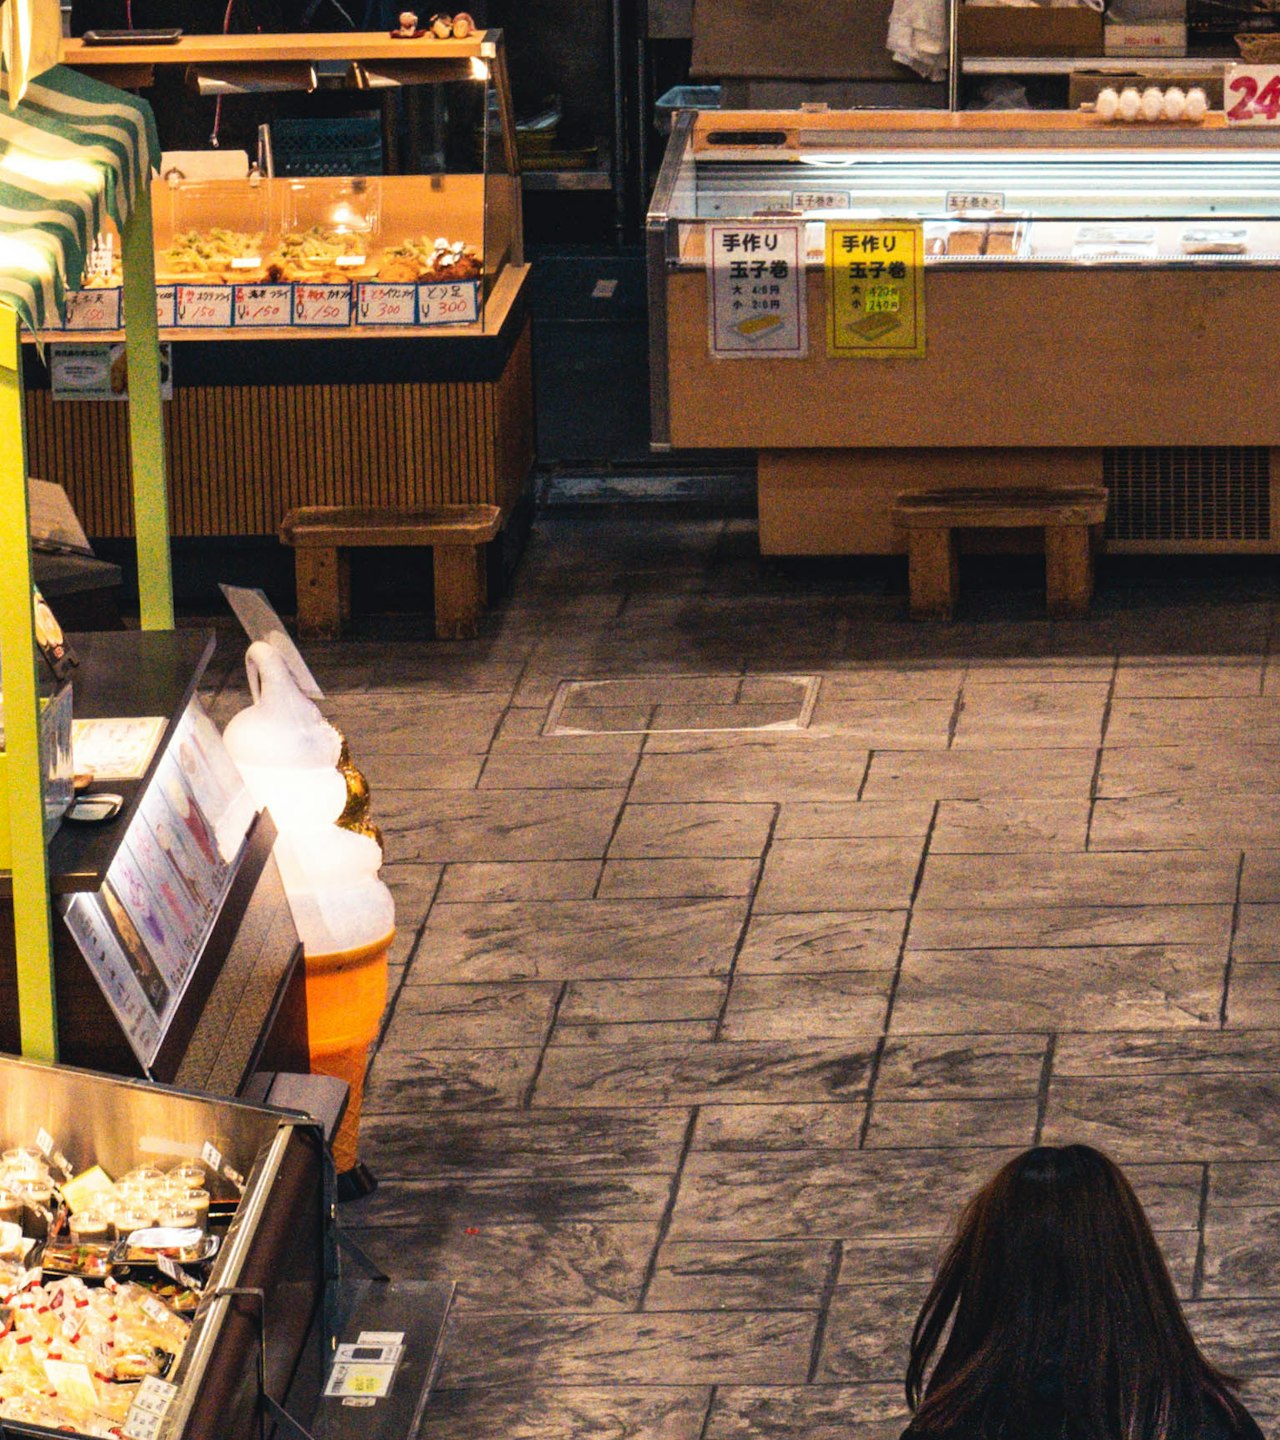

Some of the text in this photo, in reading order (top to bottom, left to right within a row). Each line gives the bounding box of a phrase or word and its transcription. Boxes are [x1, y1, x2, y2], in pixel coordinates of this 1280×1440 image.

[722, 234, 778, 253] 手作り
[842, 235, 896, 253] 手作り
[730, 262, 788, 279] 玉子巻
[849, 262, 906, 279] 玉子巻
